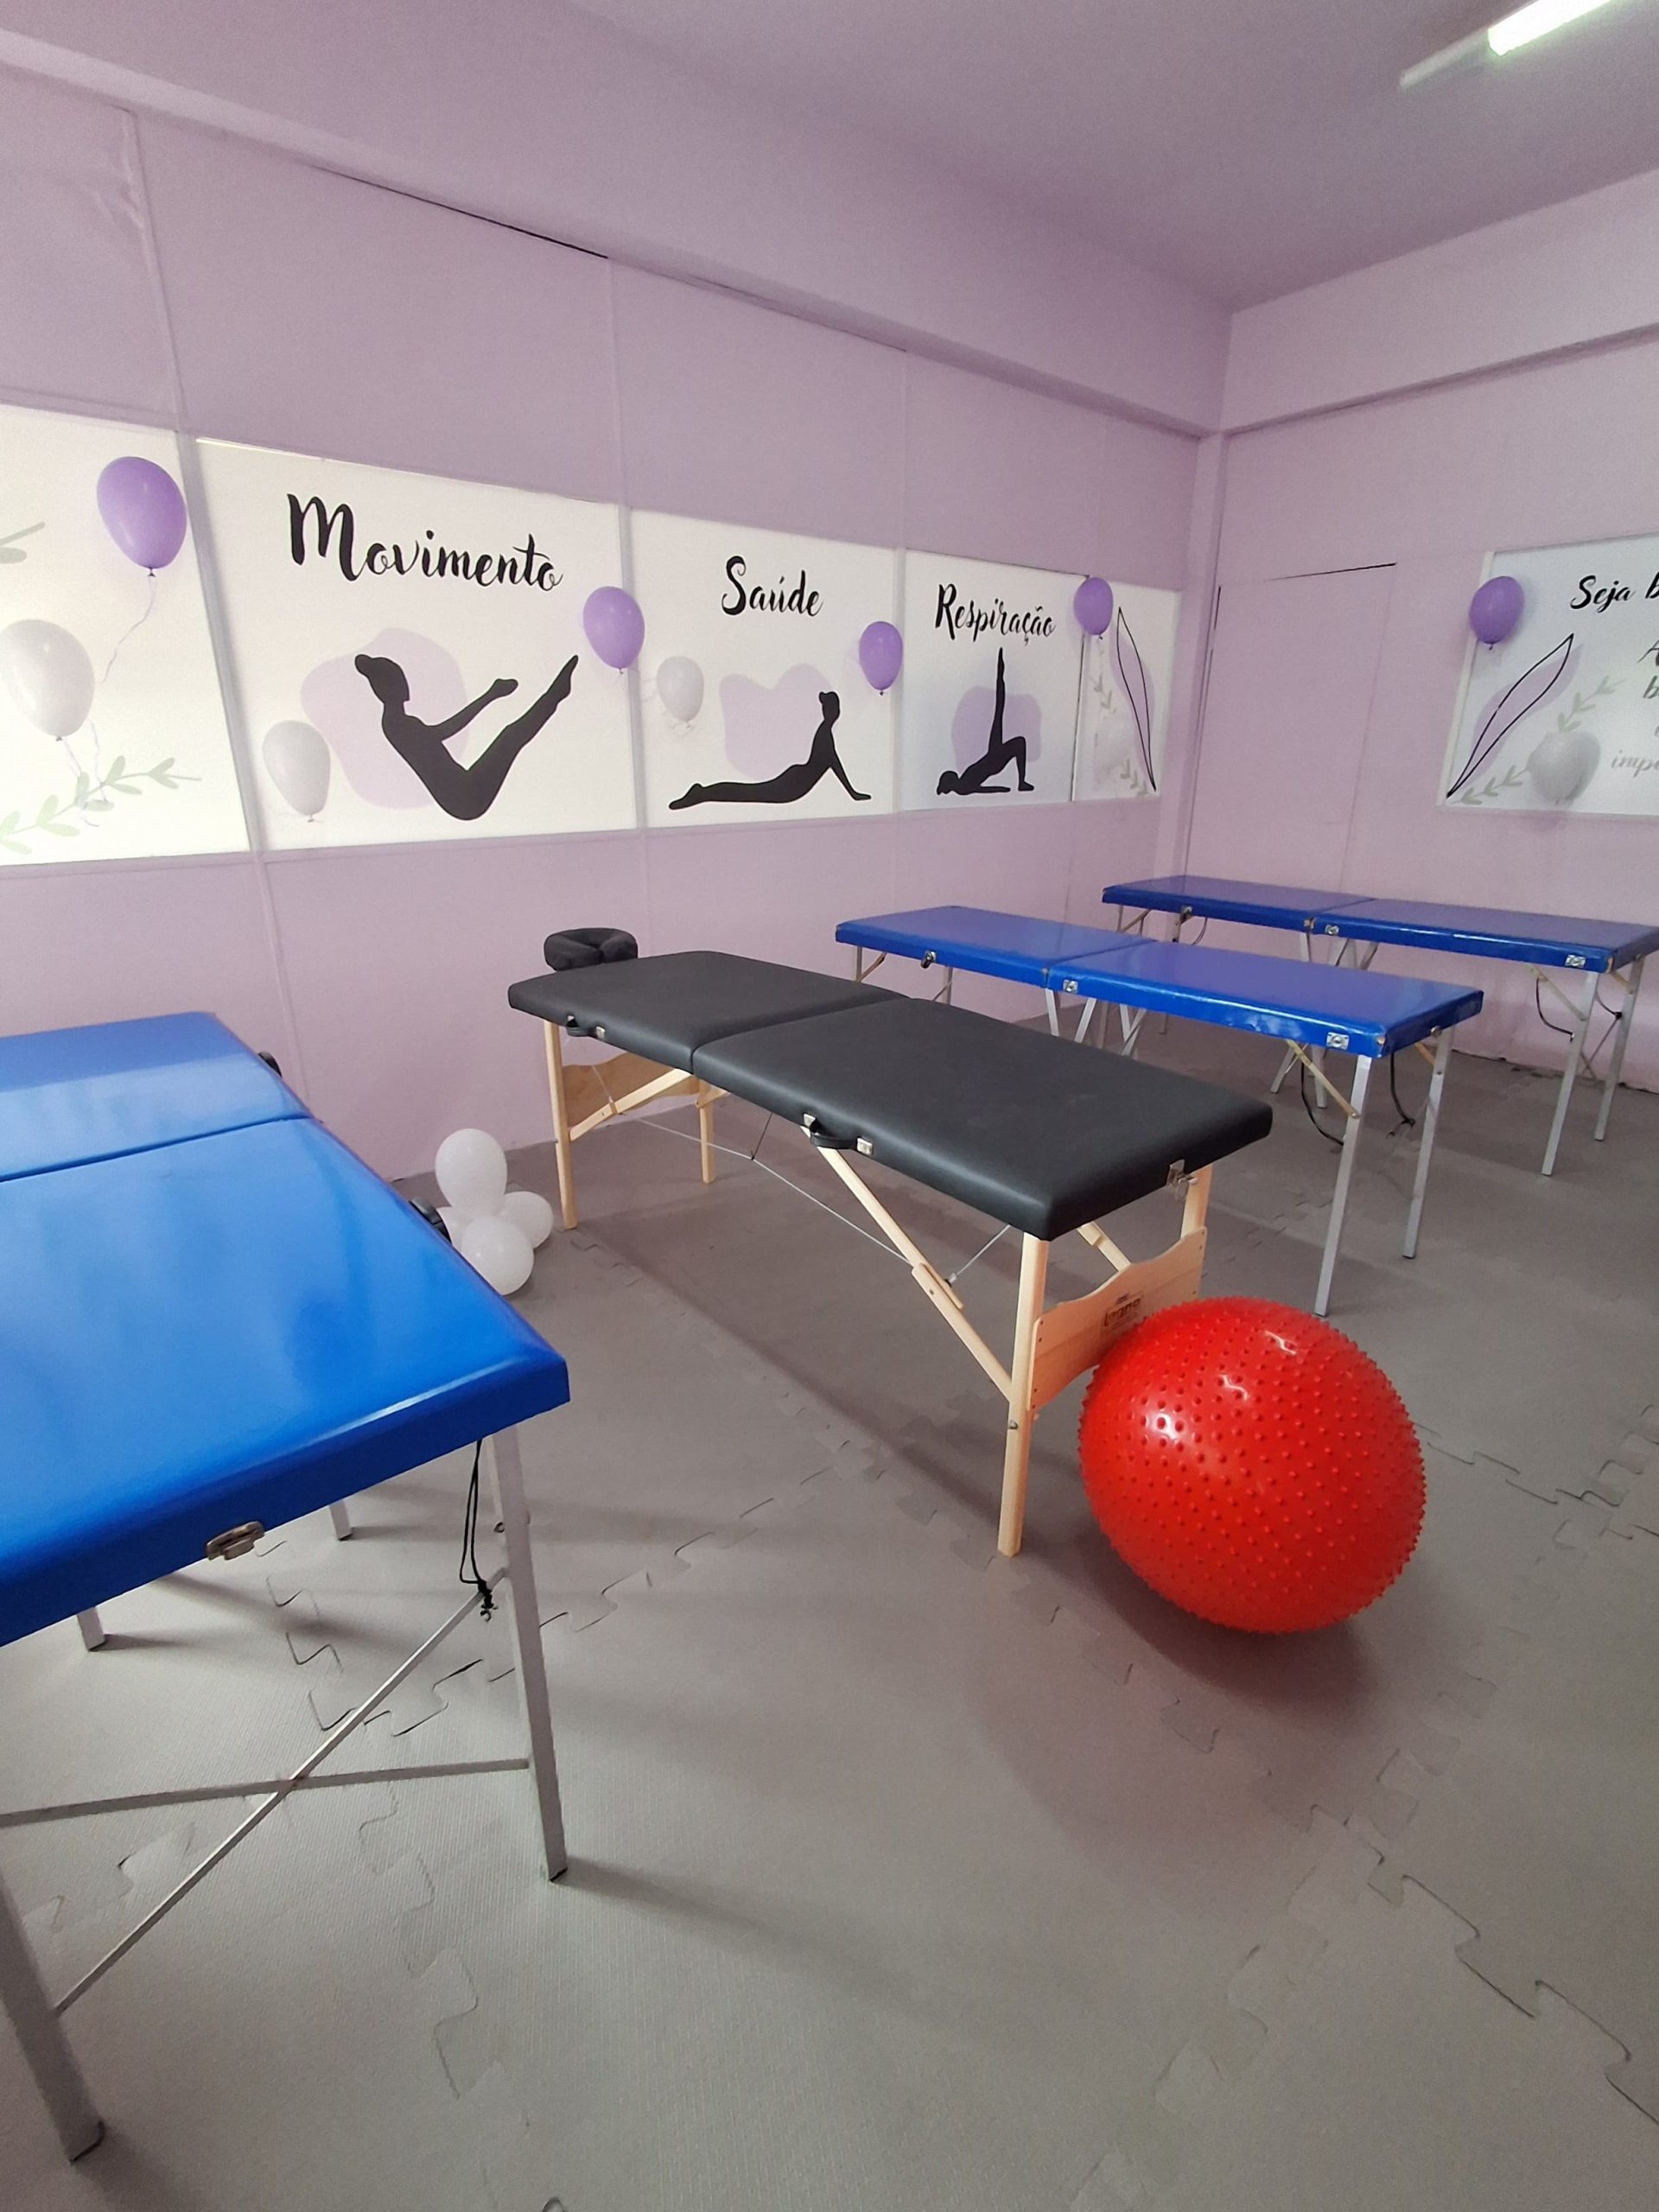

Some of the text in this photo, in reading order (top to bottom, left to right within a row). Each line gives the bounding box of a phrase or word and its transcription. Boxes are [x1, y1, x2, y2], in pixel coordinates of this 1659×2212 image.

[286, 493, 563, 592] Movimento
[721, 555, 823, 617] Saúde
[934, 583, 1055, 645] Respiração
[1569, 575, 1636, 613] Seja
